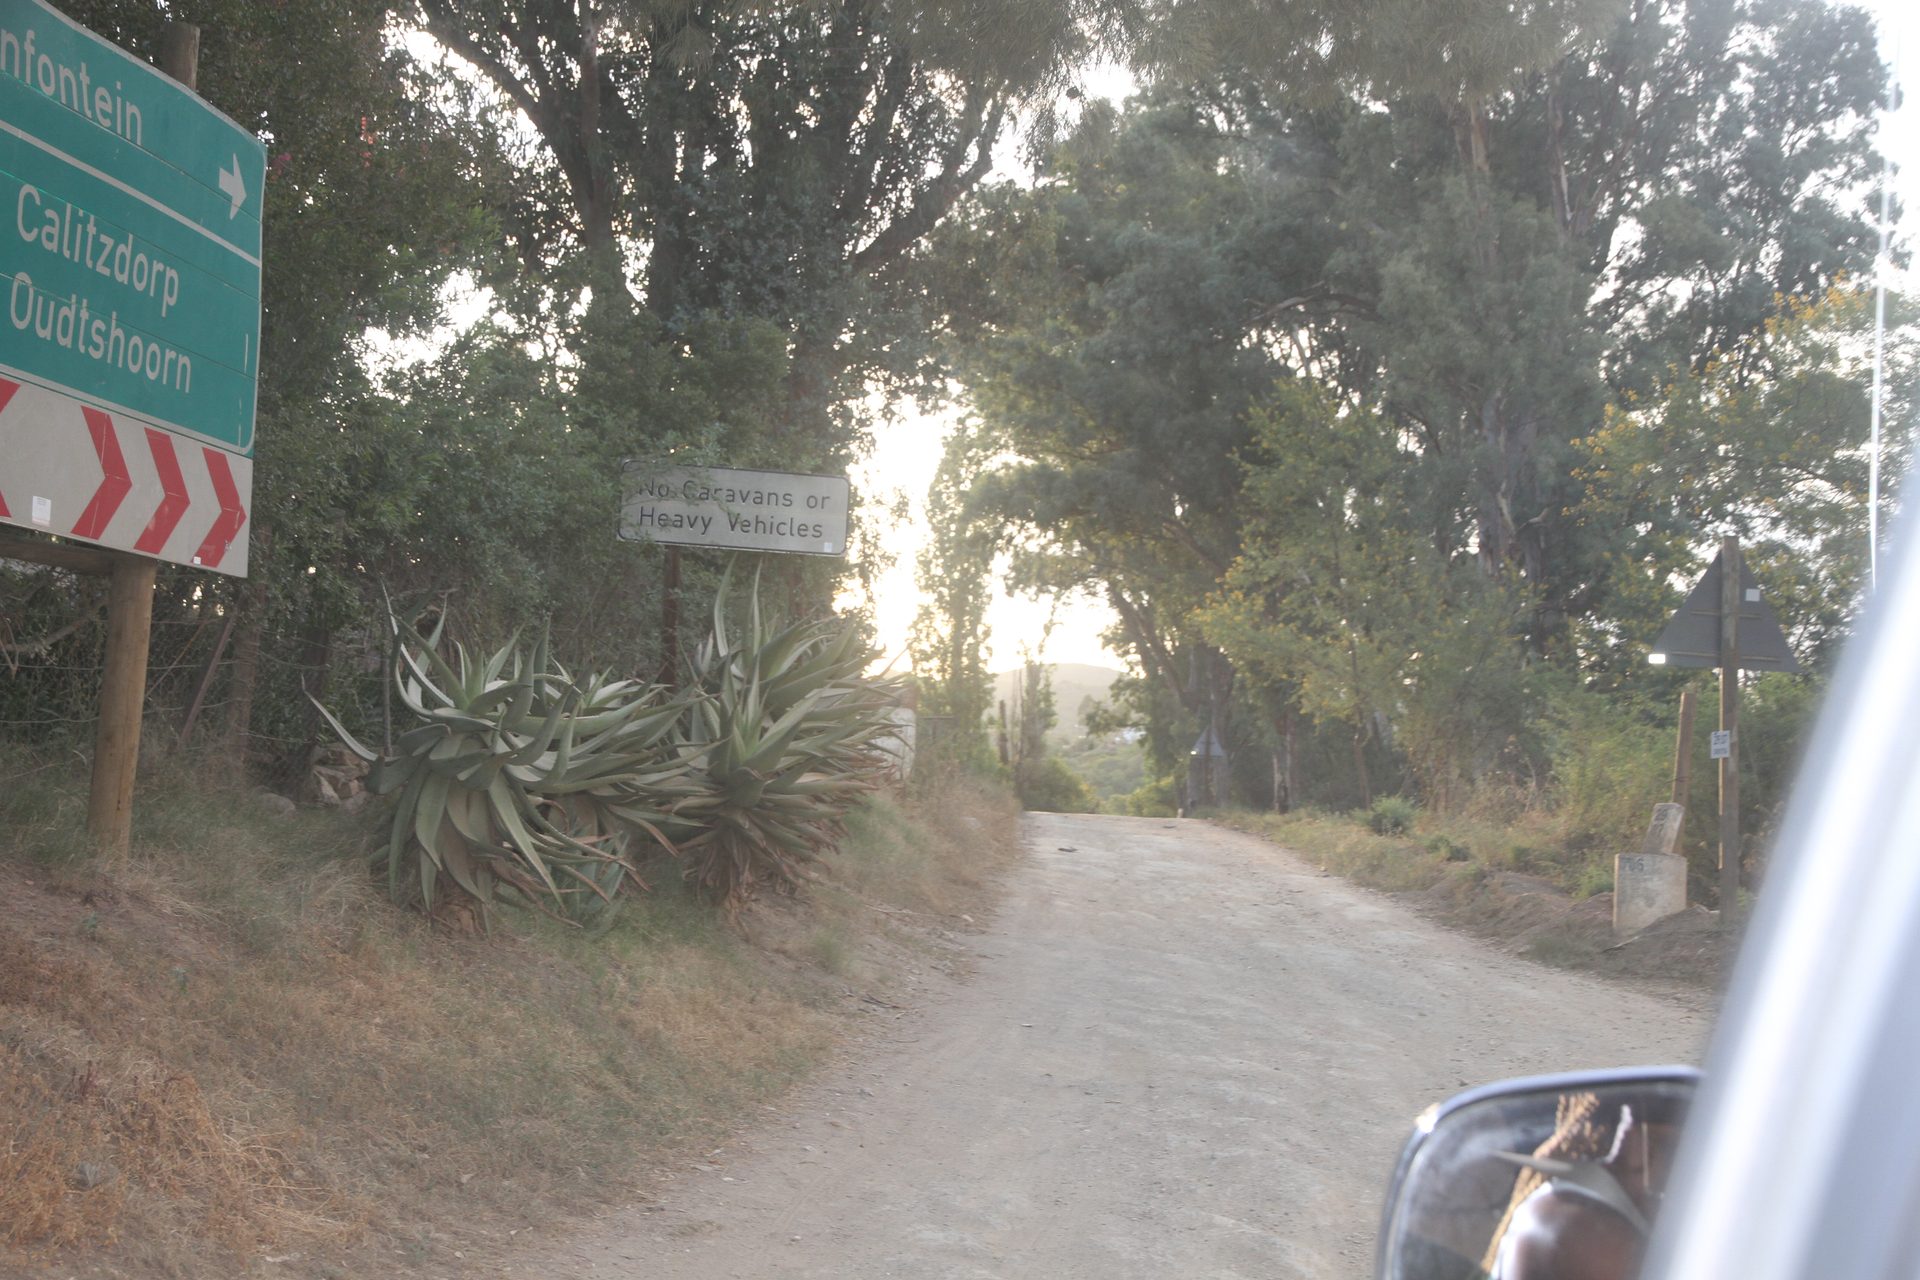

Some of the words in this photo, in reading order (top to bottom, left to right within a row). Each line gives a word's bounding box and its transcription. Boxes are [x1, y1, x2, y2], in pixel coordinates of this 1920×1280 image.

[1, 28, 142, 146] nfontein
[17, 184, 179, 318] Calitzdorp
[10, 272, 192, 393] Oudtshoorn
[639, 506, 713, 535] Heavy
[727, 512, 823, 538] Vehicles
[682, 480, 793, 507] Caravans
[806, 494, 831, 510] or
